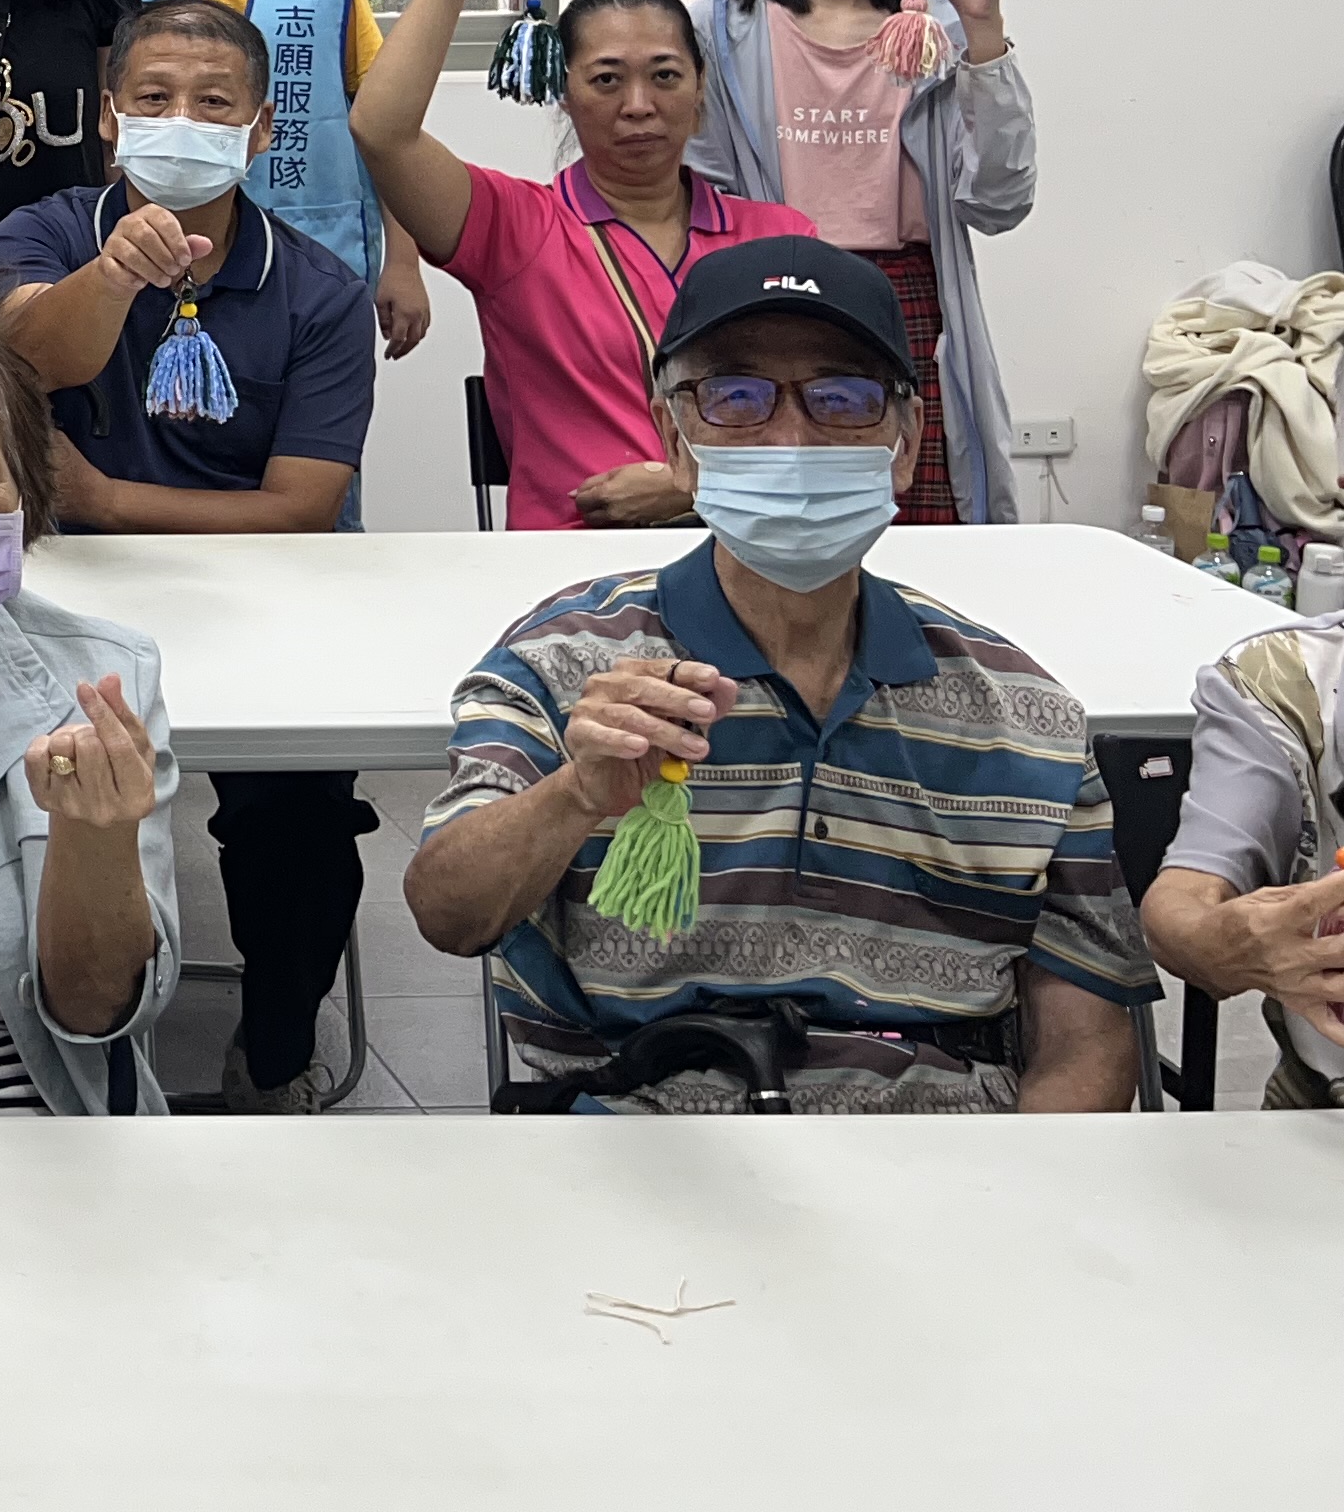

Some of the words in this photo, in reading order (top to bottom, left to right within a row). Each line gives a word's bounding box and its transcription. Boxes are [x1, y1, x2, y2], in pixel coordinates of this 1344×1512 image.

[268, 4, 316, 190] 志願服務隊
[793, 107, 868, 124] START
[776, 126, 890, 145] SOMEWHERE
[763, 276, 821, 295] FILA
